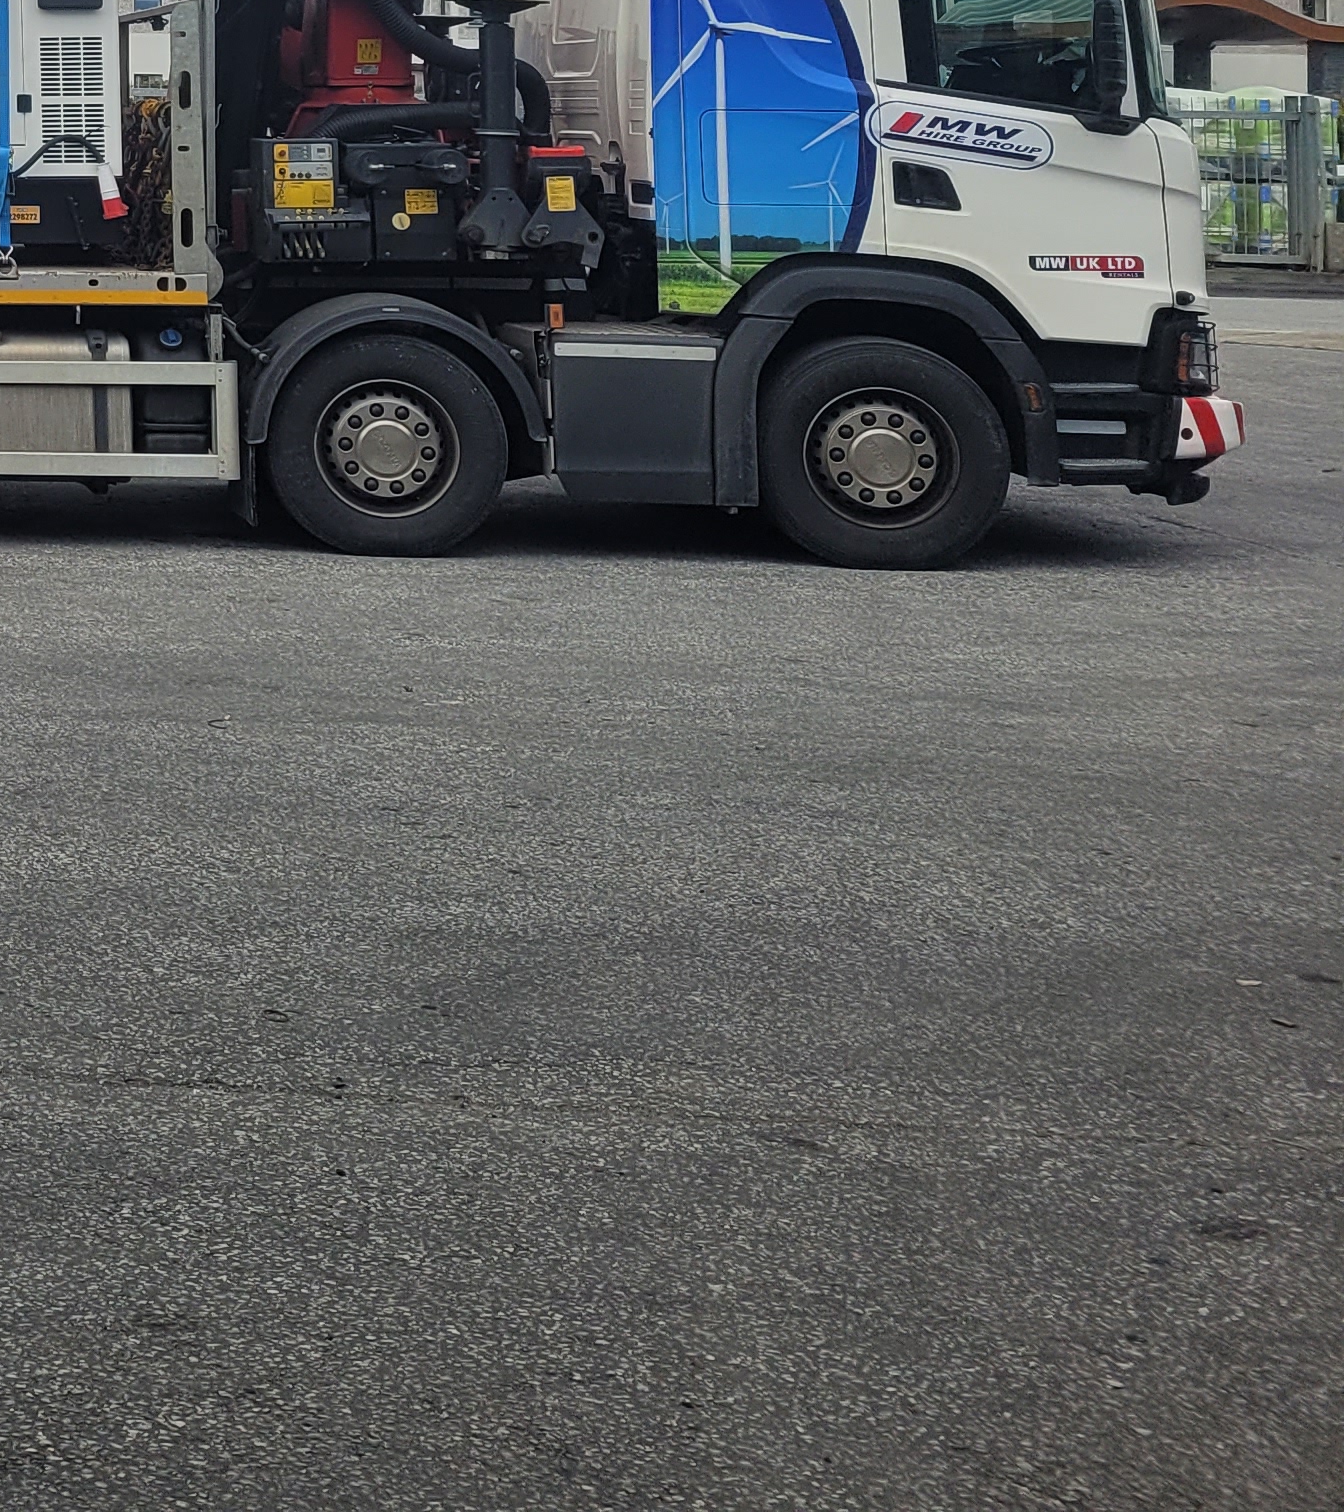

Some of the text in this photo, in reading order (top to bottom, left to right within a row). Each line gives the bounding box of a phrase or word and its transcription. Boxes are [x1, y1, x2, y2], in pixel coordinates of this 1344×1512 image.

[926, 116, 1025, 140] MW
[918, 129, 1043, 155] HIRE GROUP
[1035, 257, 1136, 270] MW UK LTD
